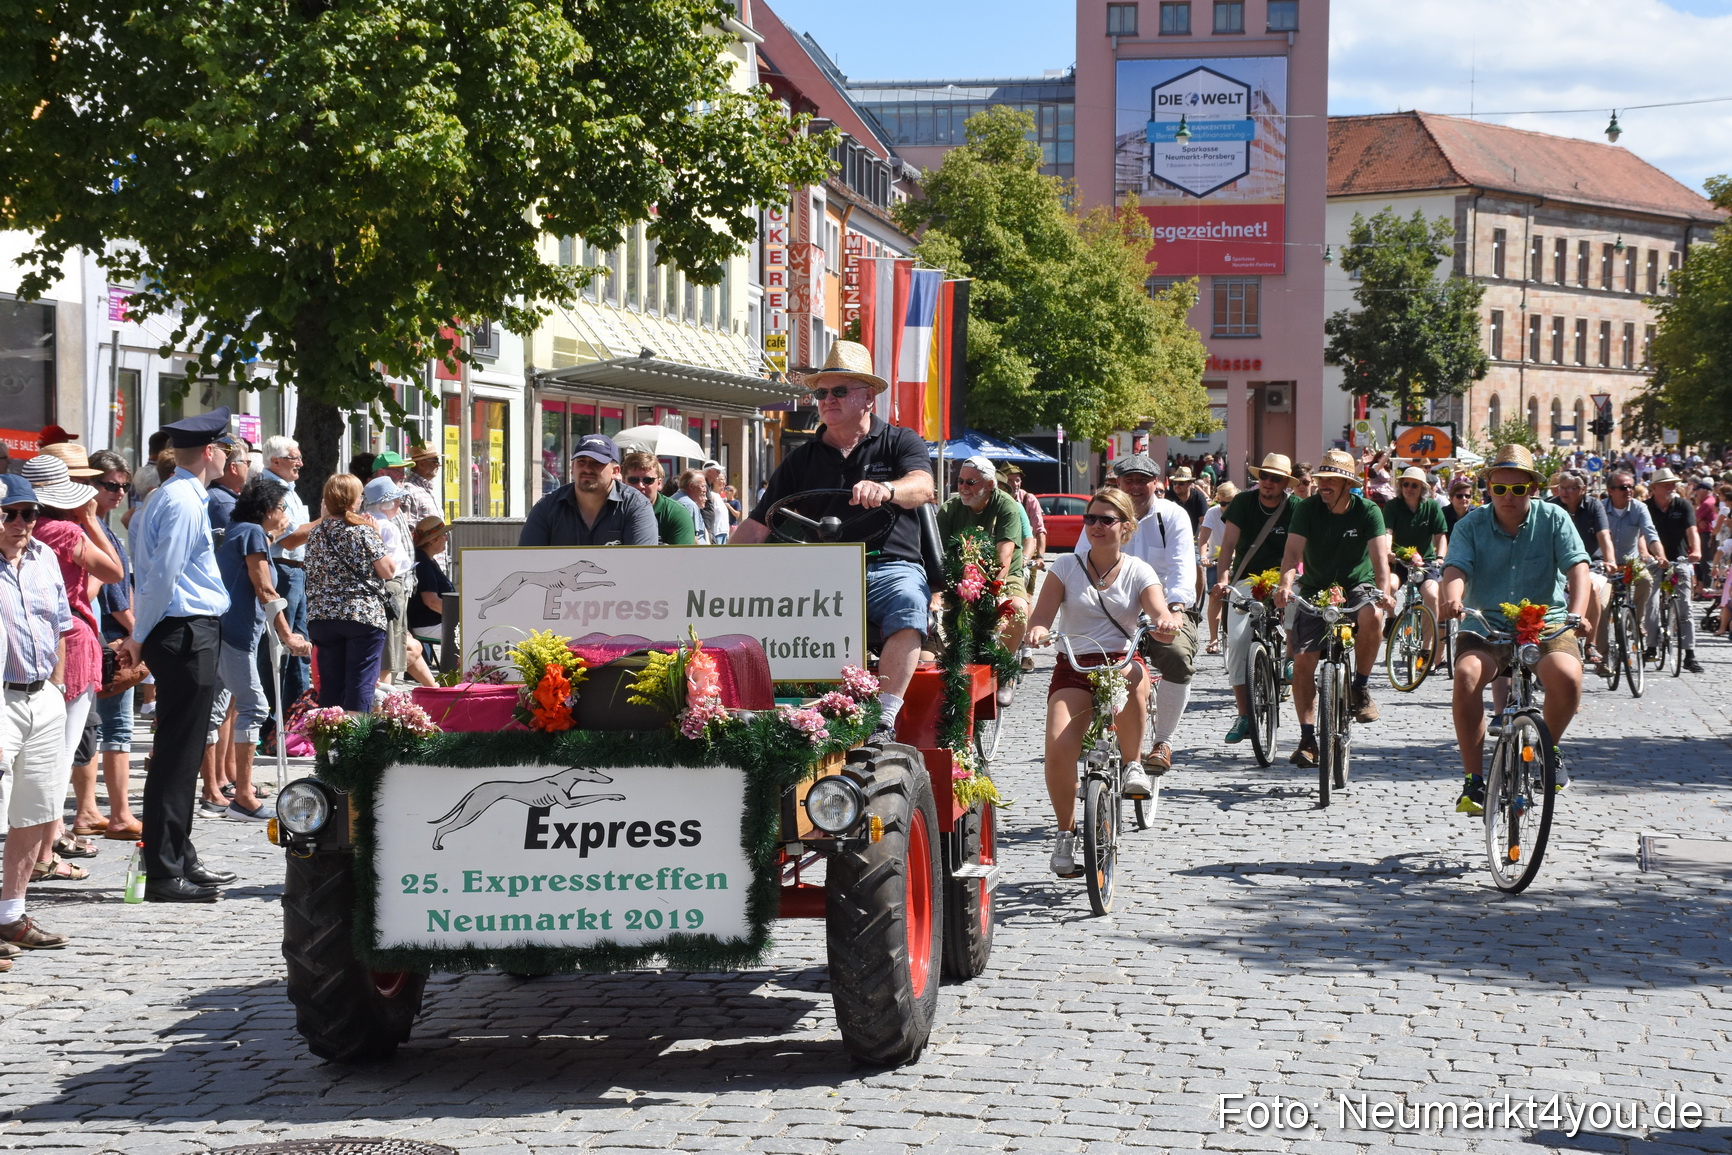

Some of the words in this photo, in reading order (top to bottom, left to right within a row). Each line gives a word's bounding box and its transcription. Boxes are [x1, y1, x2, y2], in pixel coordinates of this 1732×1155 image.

[1158, 94, 1183, 106] DIE
[1165, 153, 1236, 161] Neumarkt-Parsberg
[1182, 145, 1219, 153] Sparkasse
[1148, 221, 1268, 243] sgezeichnet!
[846, 236, 861, 327] METZG
[766, 335, 786, 349] café
[1205, 354, 1262, 371] rkasse
[19, 440, 34, 451] SALE
[543, 589, 669, 626] Express
[686, 589, 844, 618] Neumarkt
[477, 639, 518, 662] hei
[761, 636, 836, 659] ltoffen
[524, 806, 702, 858] Express
[401, 872, 449, 894] 25.
[462, 867, 729, 898] Expresstreffen
[427, 907, 614, 932] Neumarkt
[624, 908, 706, 931] 2019
